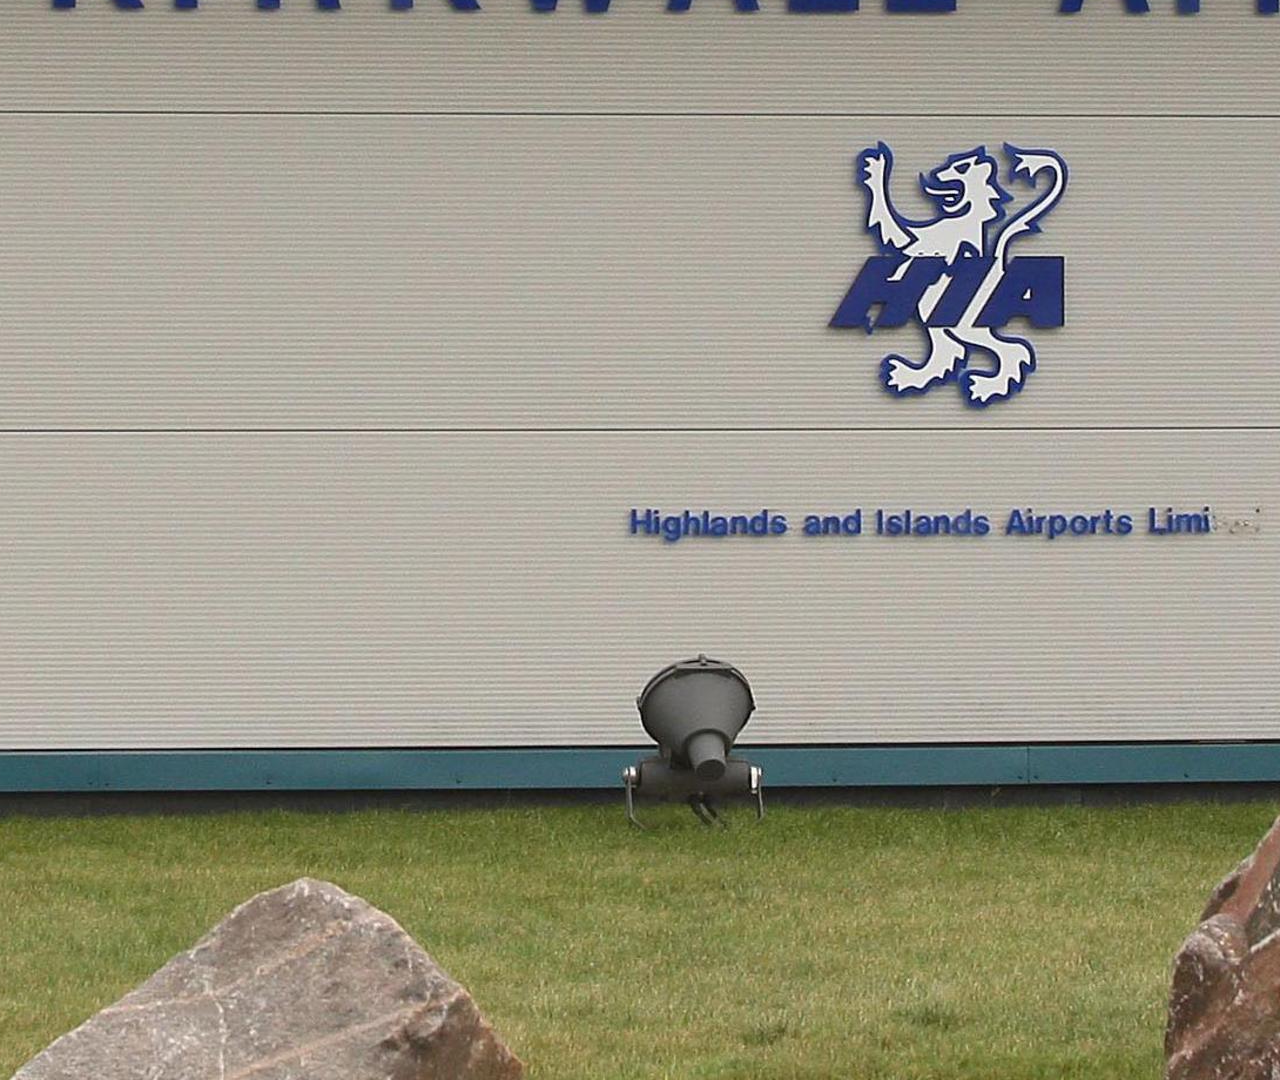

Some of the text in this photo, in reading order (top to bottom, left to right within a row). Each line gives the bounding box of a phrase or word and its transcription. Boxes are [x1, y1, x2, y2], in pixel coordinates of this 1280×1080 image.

[629, 507, 788, 542] Highlands
[804, 508, 864, 535] and
[875, 508, 991, 536] Islands
[1006, 507, 1133, 541] Airports
